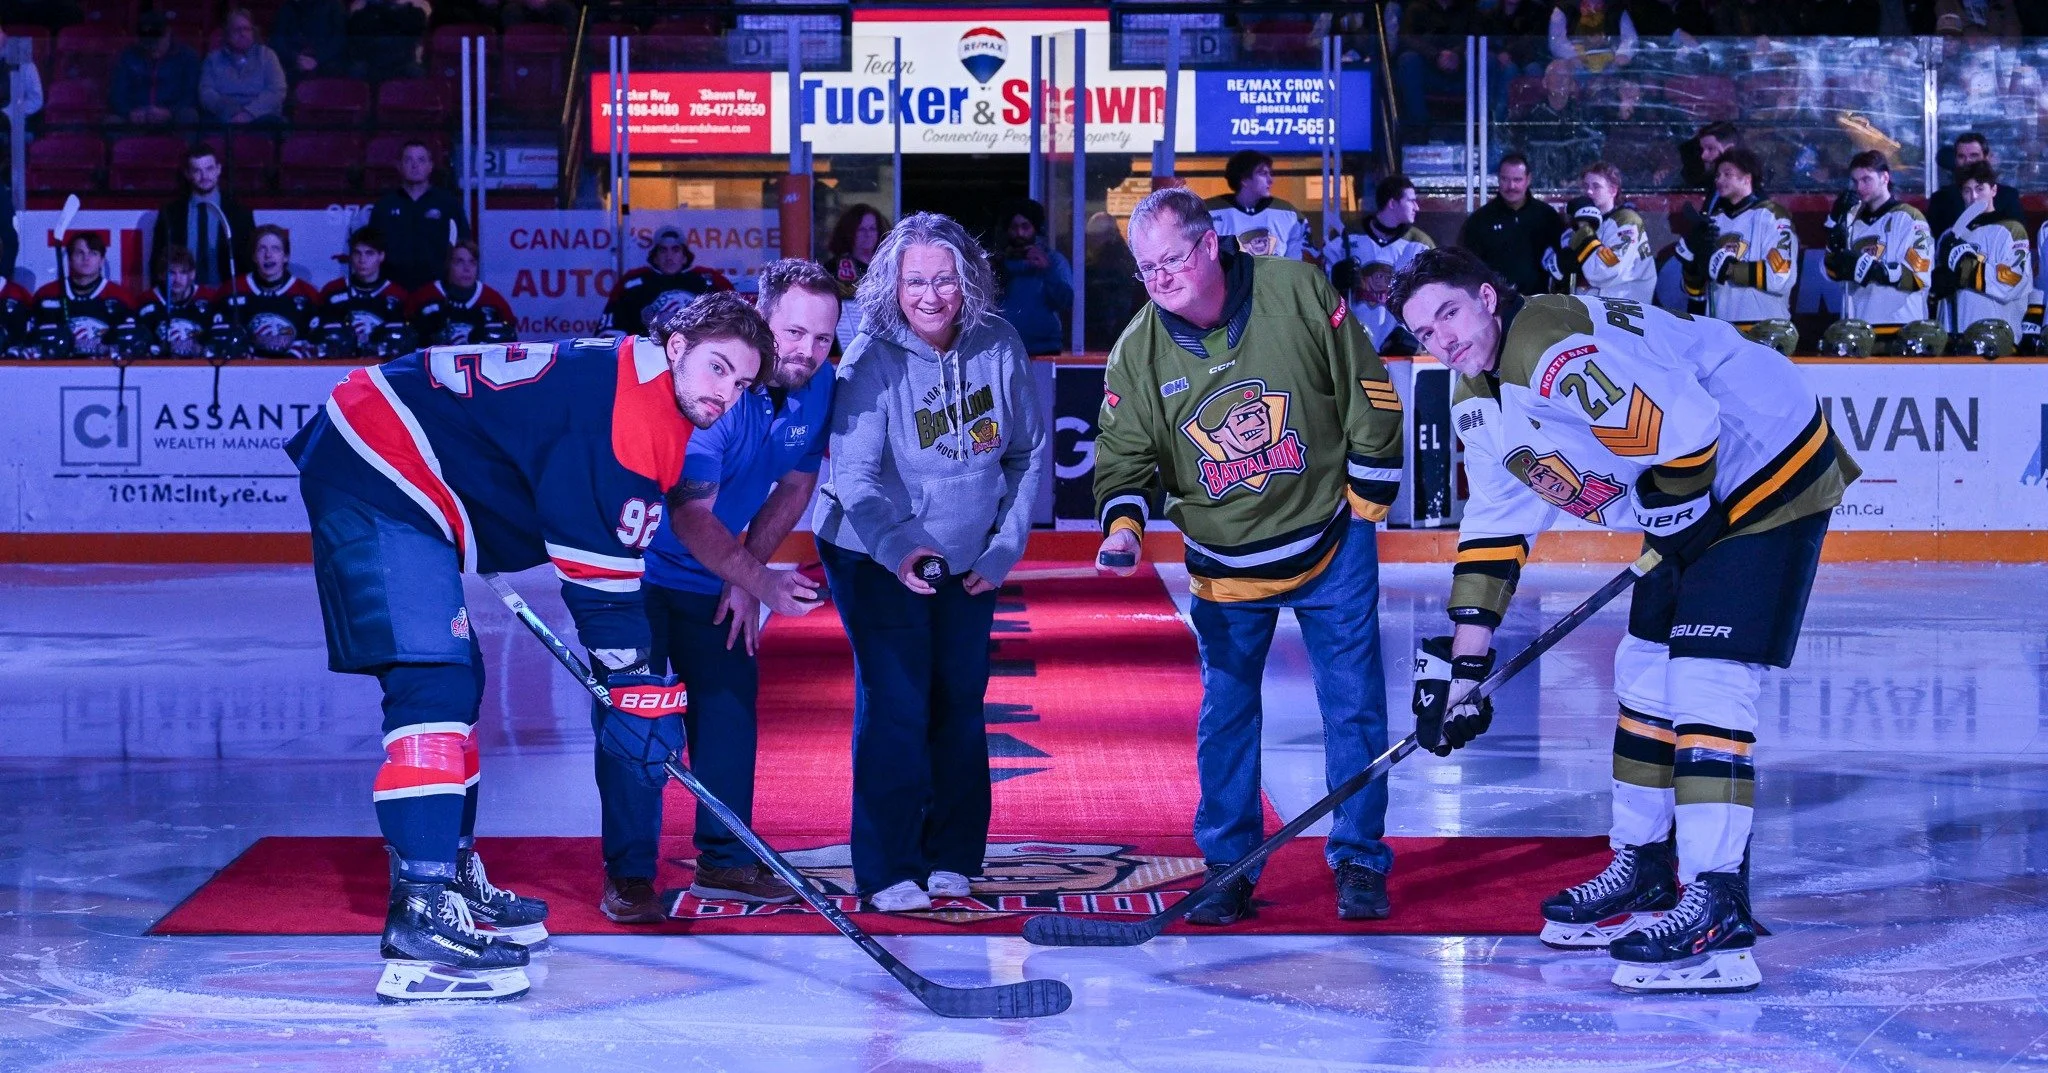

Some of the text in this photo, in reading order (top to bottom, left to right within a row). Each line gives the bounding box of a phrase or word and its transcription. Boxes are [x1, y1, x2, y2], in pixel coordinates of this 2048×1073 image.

[963, 41, 1003, 52] RE/MAX
[1226, 78, 1282, 92] RE/MAX
[801, 79, 969, 125] Tucker
[973, 100, 996, 125] &
[1239, 91, 1325, 105] REALTY INC.
[1255, 104, 1310, 115] BROKERAGE
[922, 127, 999, 150] Connecting
[686, 228, 781, 250] ARAGE
[1208, 359, 1236, 375] CCM
[1541, 346, 1590, 390] NORTH BAY
[1161, 377, 1189, 397] OHL
[1559, 358, 1627, 421] 21
[73, 404, 129, 449] CI
[154, 403, 325, 431] ASSANT
[154, 437, 216, 450] WEALTH
[935, 441, 970, 460] HOCKY
[1202, 435, 1302, 495] BATTALION
[616, 497, 663, 549] 92
[1637, 507, 1694, 528] UER
[1670, 623, 1733, 639] BAUER
[430, 933, 481, 958] BAUER
